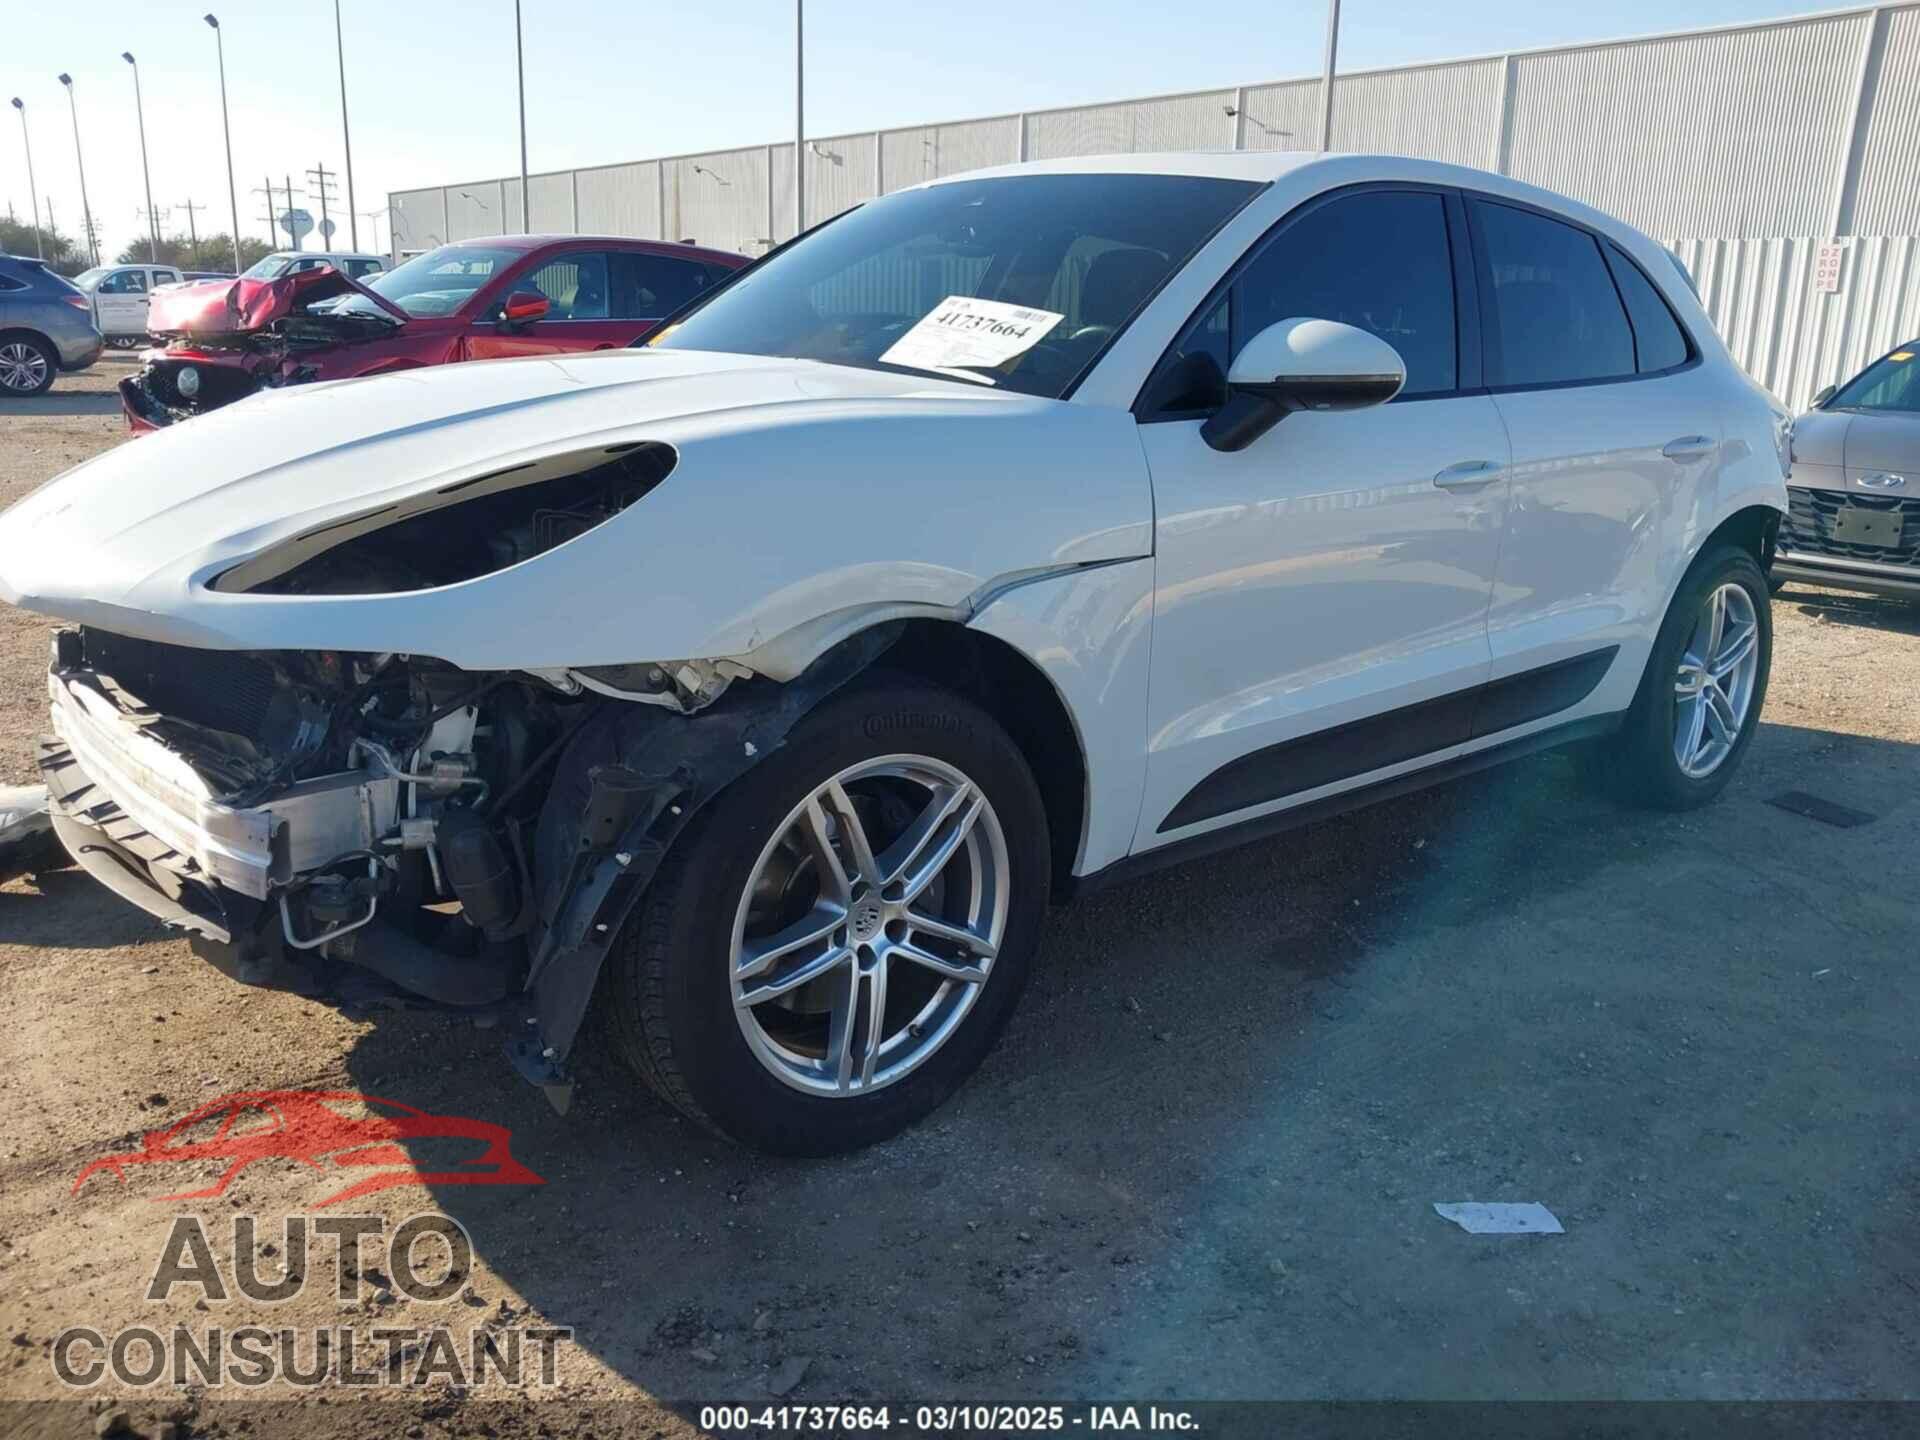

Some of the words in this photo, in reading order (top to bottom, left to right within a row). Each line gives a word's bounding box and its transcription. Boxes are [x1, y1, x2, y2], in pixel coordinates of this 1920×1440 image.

[1816, 248, 1830, 288] DROP
[1826, 248, 1840, 288] ZONE
[937, 311, 1032, 340] 41737664
[863, 706, 961, 738] Continental
